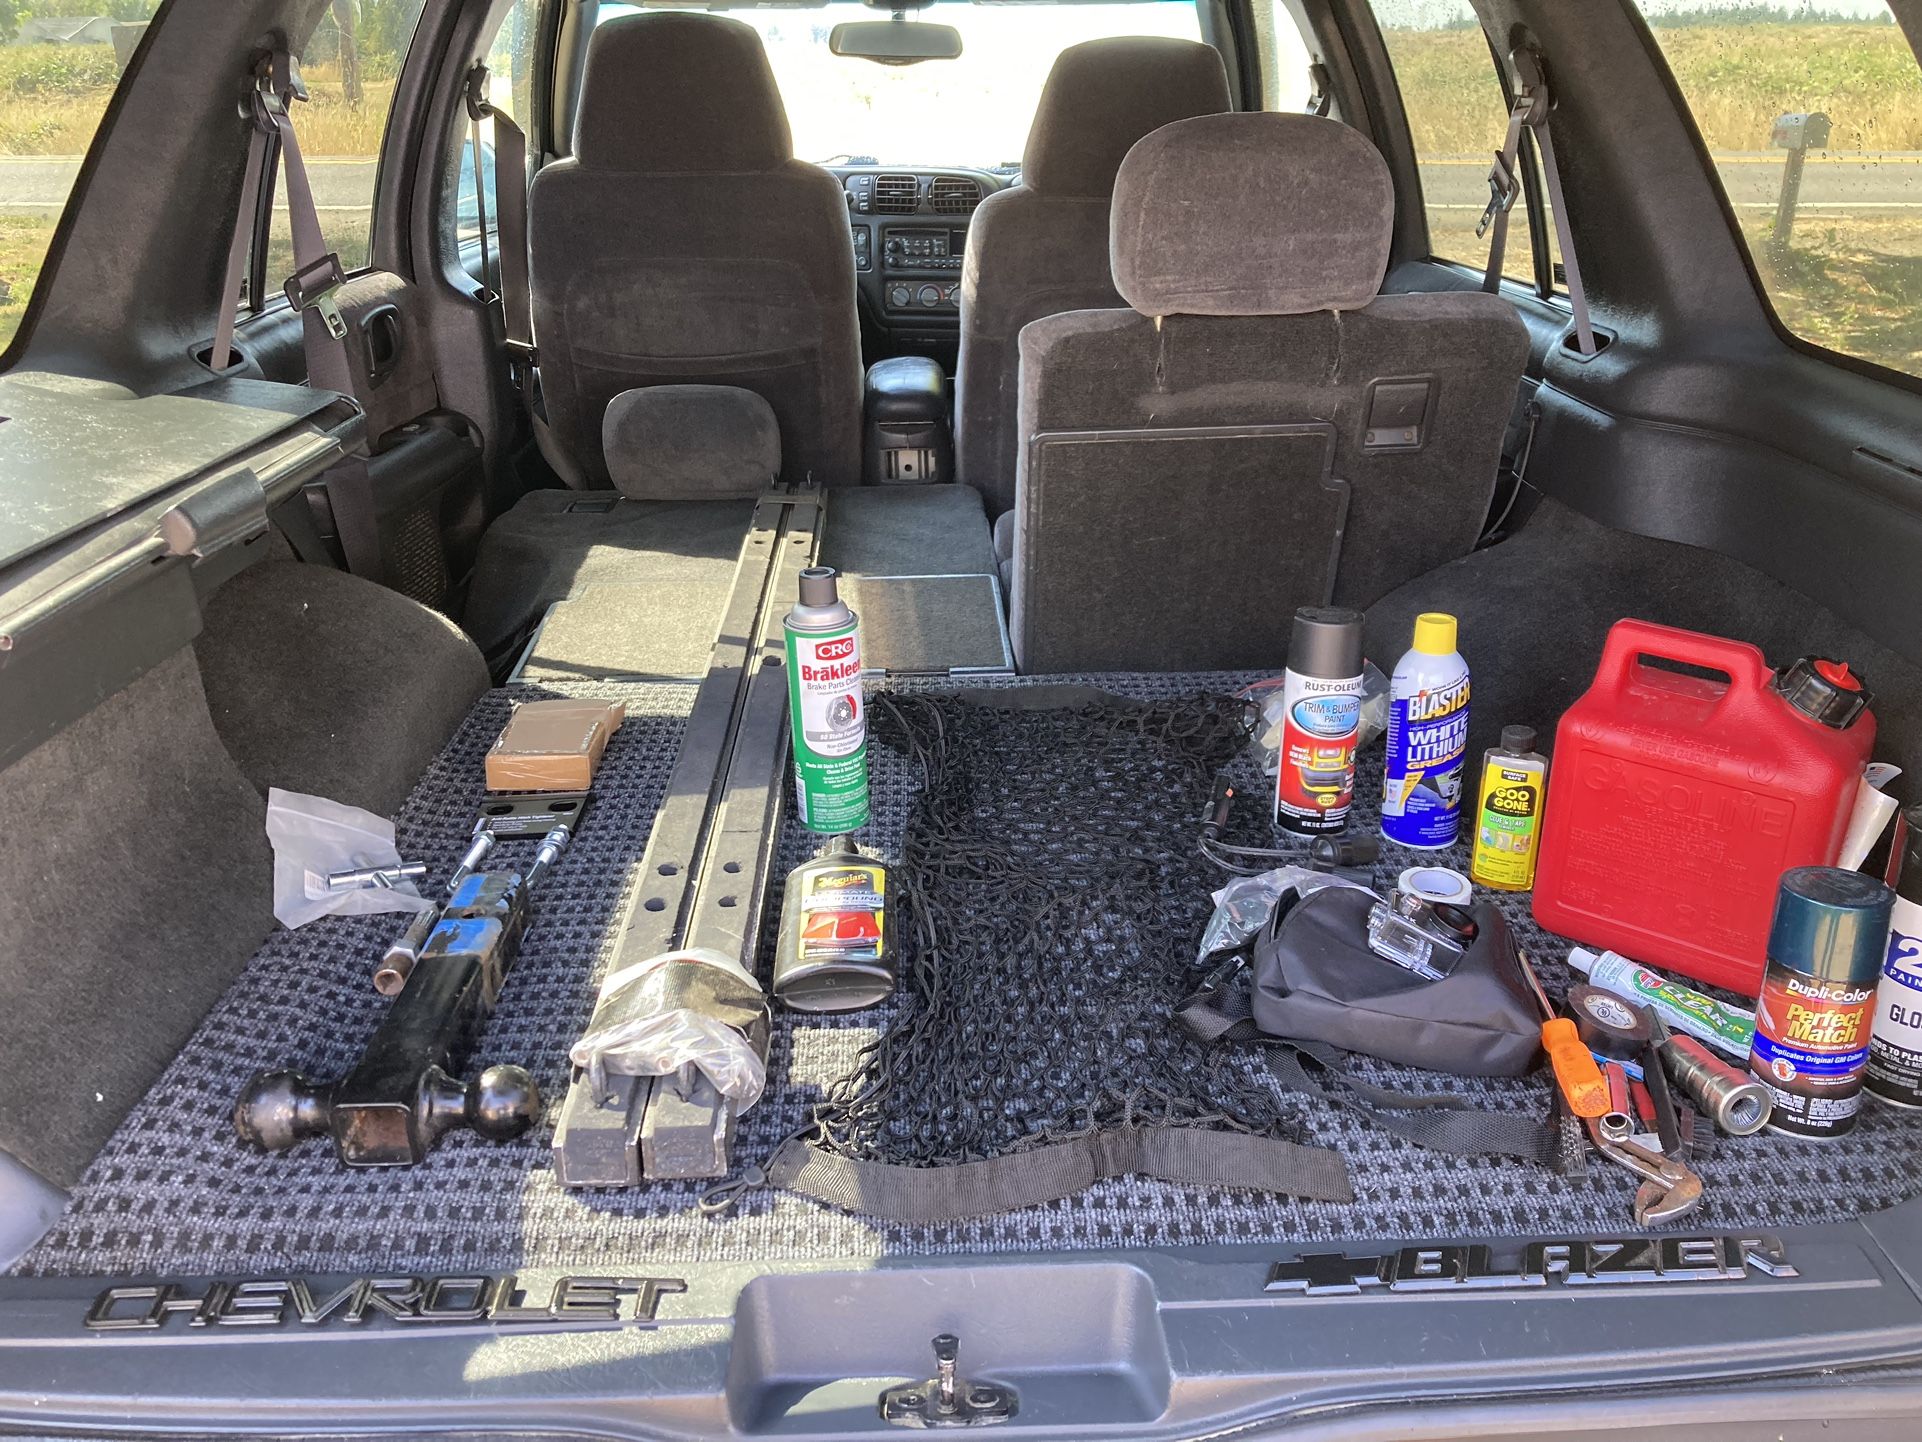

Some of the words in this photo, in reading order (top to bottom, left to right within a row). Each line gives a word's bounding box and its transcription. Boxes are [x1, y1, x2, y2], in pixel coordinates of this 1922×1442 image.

[817, 640, 852, 657] CRC
[807, 682, 827, 690] Brake
[828, 681, 845, 690] Parts
[1304, 702, 1325, 713] TRIM
[1325, 715, 1345, 723] PAINT
[1408, 711, 1469, 746] WHITE
[1407, 726, 1467, 762] LITHIUM
[1494, 797, 1529, 811] GONE
[1496, 787, 1530, 801] GOO
[1582, 765, 1788, 839] GASOLINE
[1788, 979, 1871, 1002] Dupli-Color
[1664, 986, 1728, 1027] CLEAR
[1786, 1003, 1864, 1028] Perfect
[1889, 1004, 1922, 1029] GLO
[1782, 1036, 1809, 1048] Premium
[1787, 1020, 1858, 1043] Match
[1771, 1045, 1804, 1061] Duplicates
[1805, 1054, 1834, 1064] Original
[1834, 1055, 1846, 1064] GM
[1888, 1046, 1899, 1056] TO
[1390, 1236, 1799, 1292] BLAZER
[84, 1276, 690, 1329] CHEVROLET
